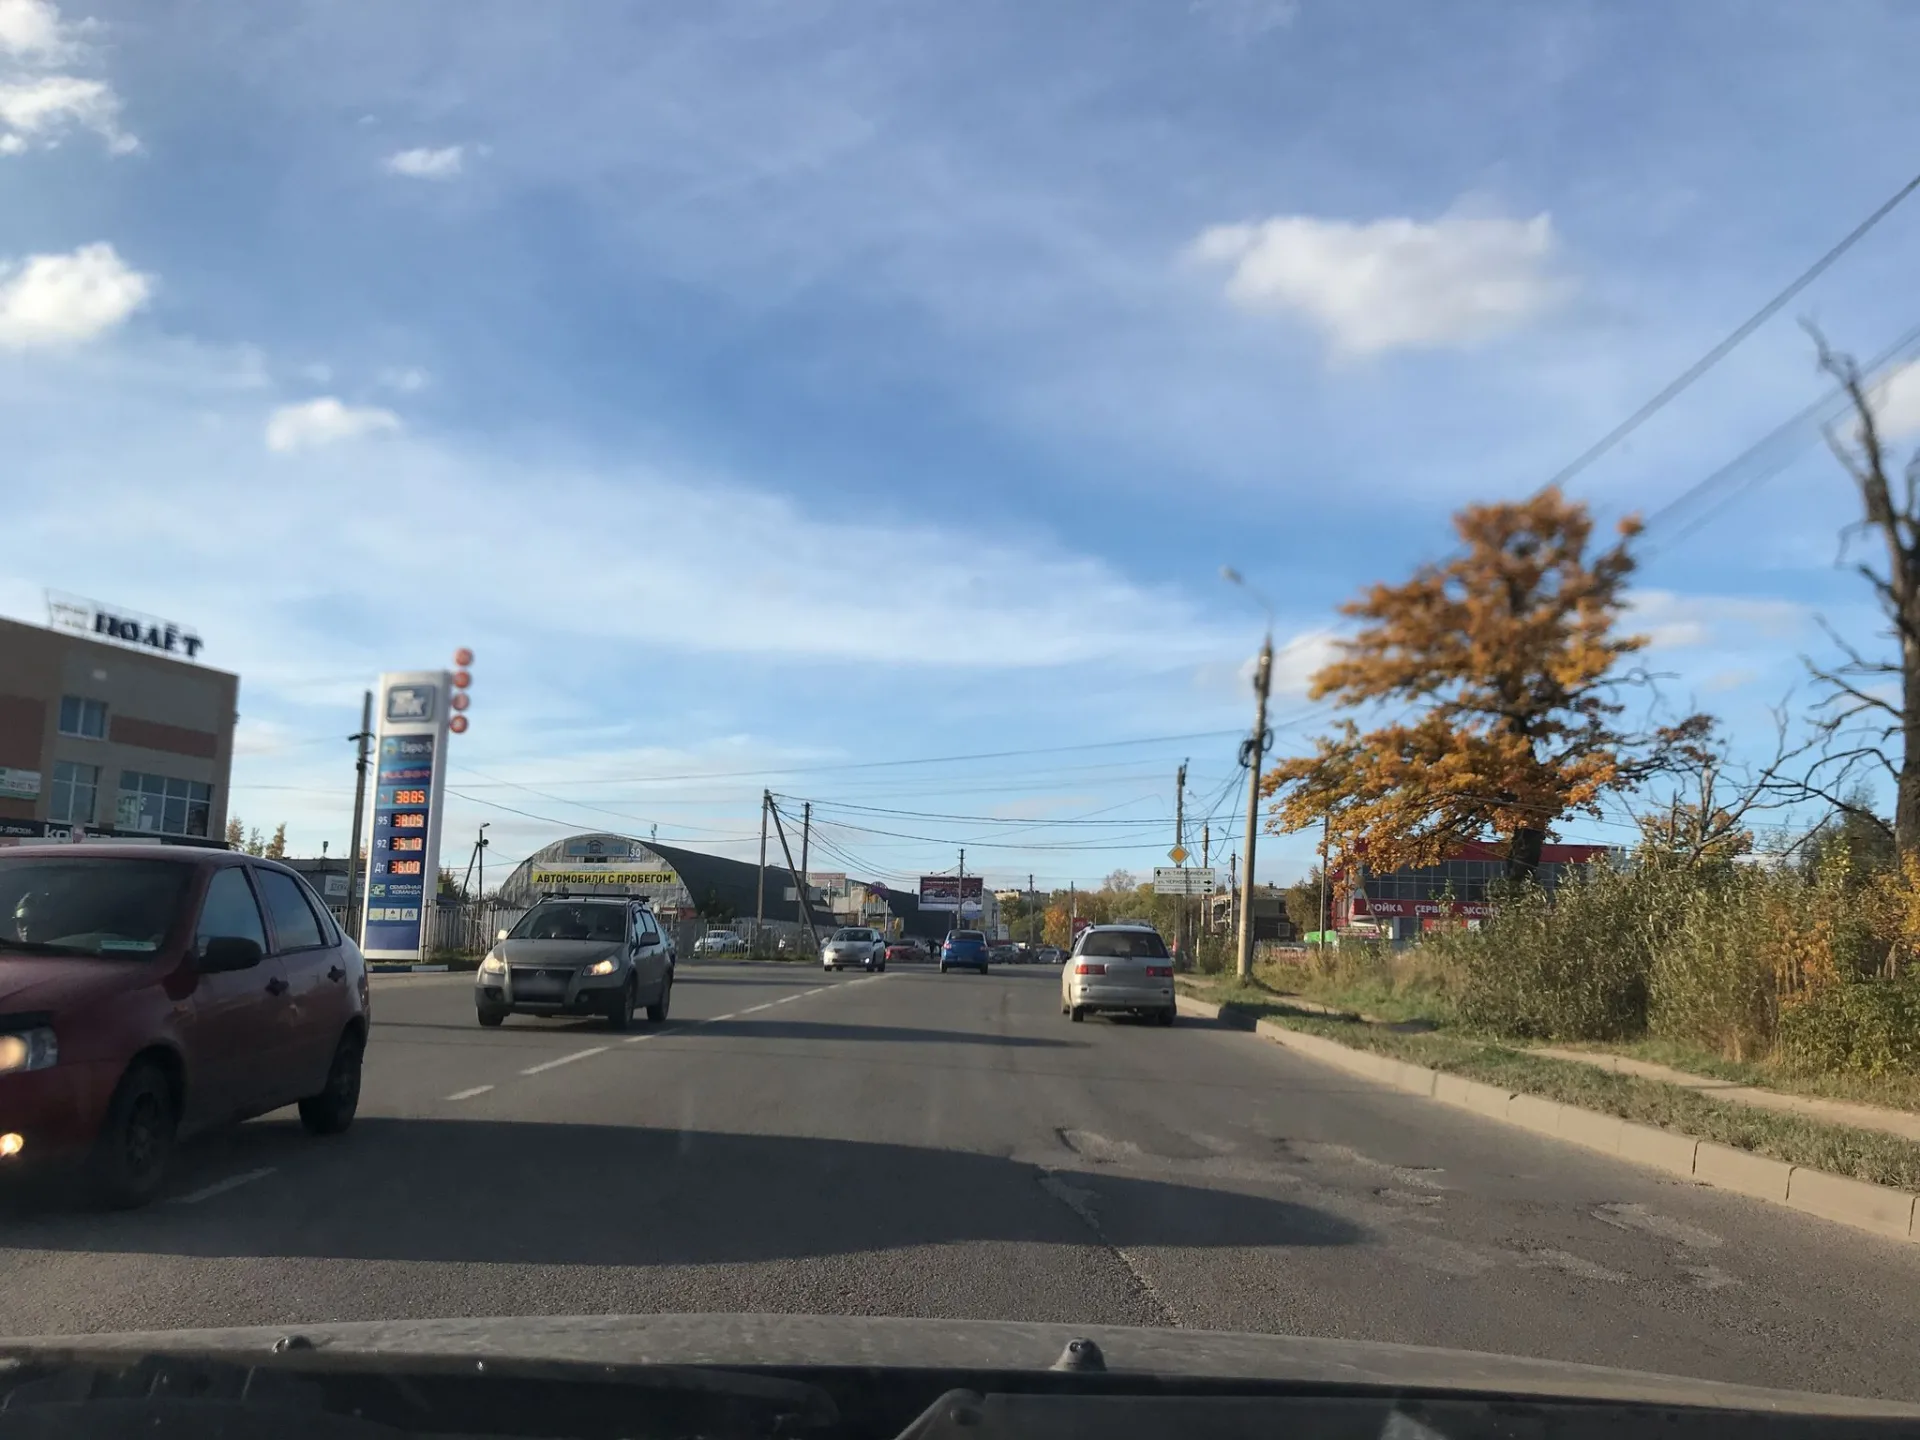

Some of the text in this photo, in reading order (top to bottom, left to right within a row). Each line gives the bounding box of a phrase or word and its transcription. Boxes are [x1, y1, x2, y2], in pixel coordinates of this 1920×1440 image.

[378, 815, 388, 825] 95
[376, 839, 386, 848] 92
[391, 861, 420, 874] 36.00
[536, 873, 672, 883] АВТОМОБИЛИ С ПРОБЕГОМ
